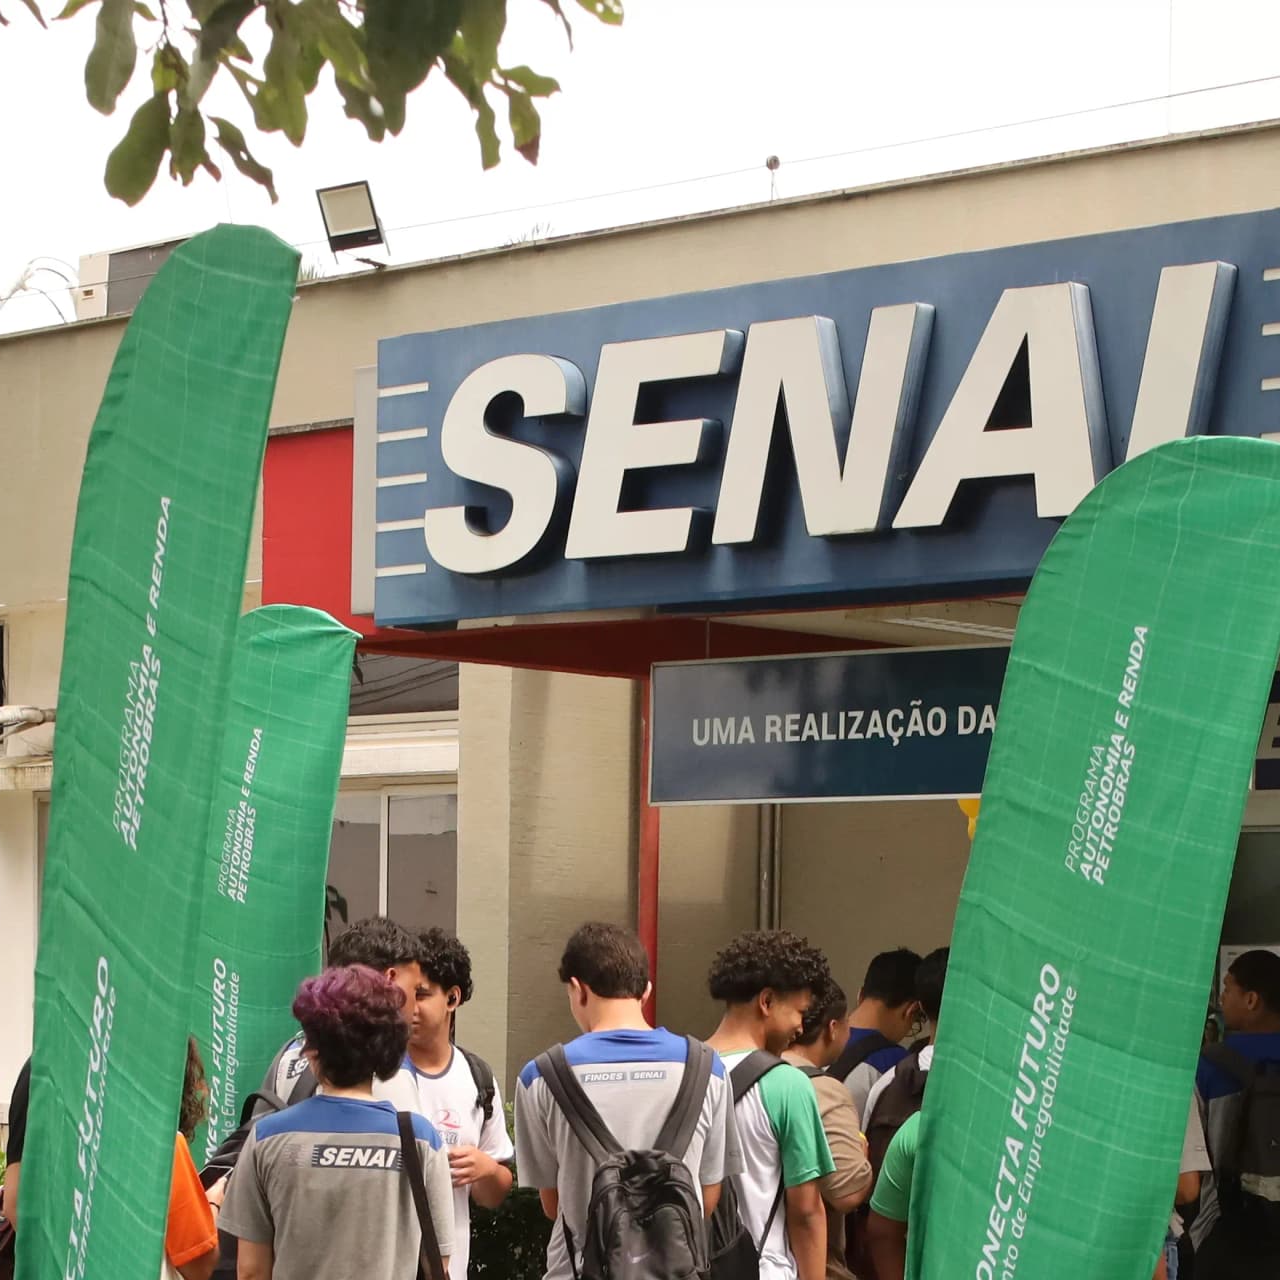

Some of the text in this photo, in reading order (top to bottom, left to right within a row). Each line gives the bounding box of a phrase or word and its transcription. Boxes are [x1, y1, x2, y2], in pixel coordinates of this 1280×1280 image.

[423, 260, 1236, 575] SENAI
[113, 661, 140, 833] PROGRAMA
[120, 497, 171, 845] AUTONOMIA E RENDA
[692, 699, 996, 747] UMA REALIZAÇÃO DA
[129, 654, 160, 851] PETROBRAS
[228, 728, 263, 901] AUTONOMIA E RENDA
[1065, 745, 1104, 872] PROGRAMA
[1080, 626, 1148, 880] AUTONOMIA E RENDA
[1093, 741, 1135, 885] PETROBRAS
[218, 809, 236, 896] PROGRAMA
[237, 806, 256, 904] PETROBRAS
[205, 957, 227, 1164] NECTA FUTURO
[221, 971, 240, 1117] Empregabilidade
[584, 1071, 663, 1083] FINDES SENAI
[1011, 963, 1061, 1131] FUTURO
[1018, 985, 1077, 1204] Empregabilidade
[320, 1147, 397, 1168] SENAI
[1011, 1208, 1027, 1239] de
